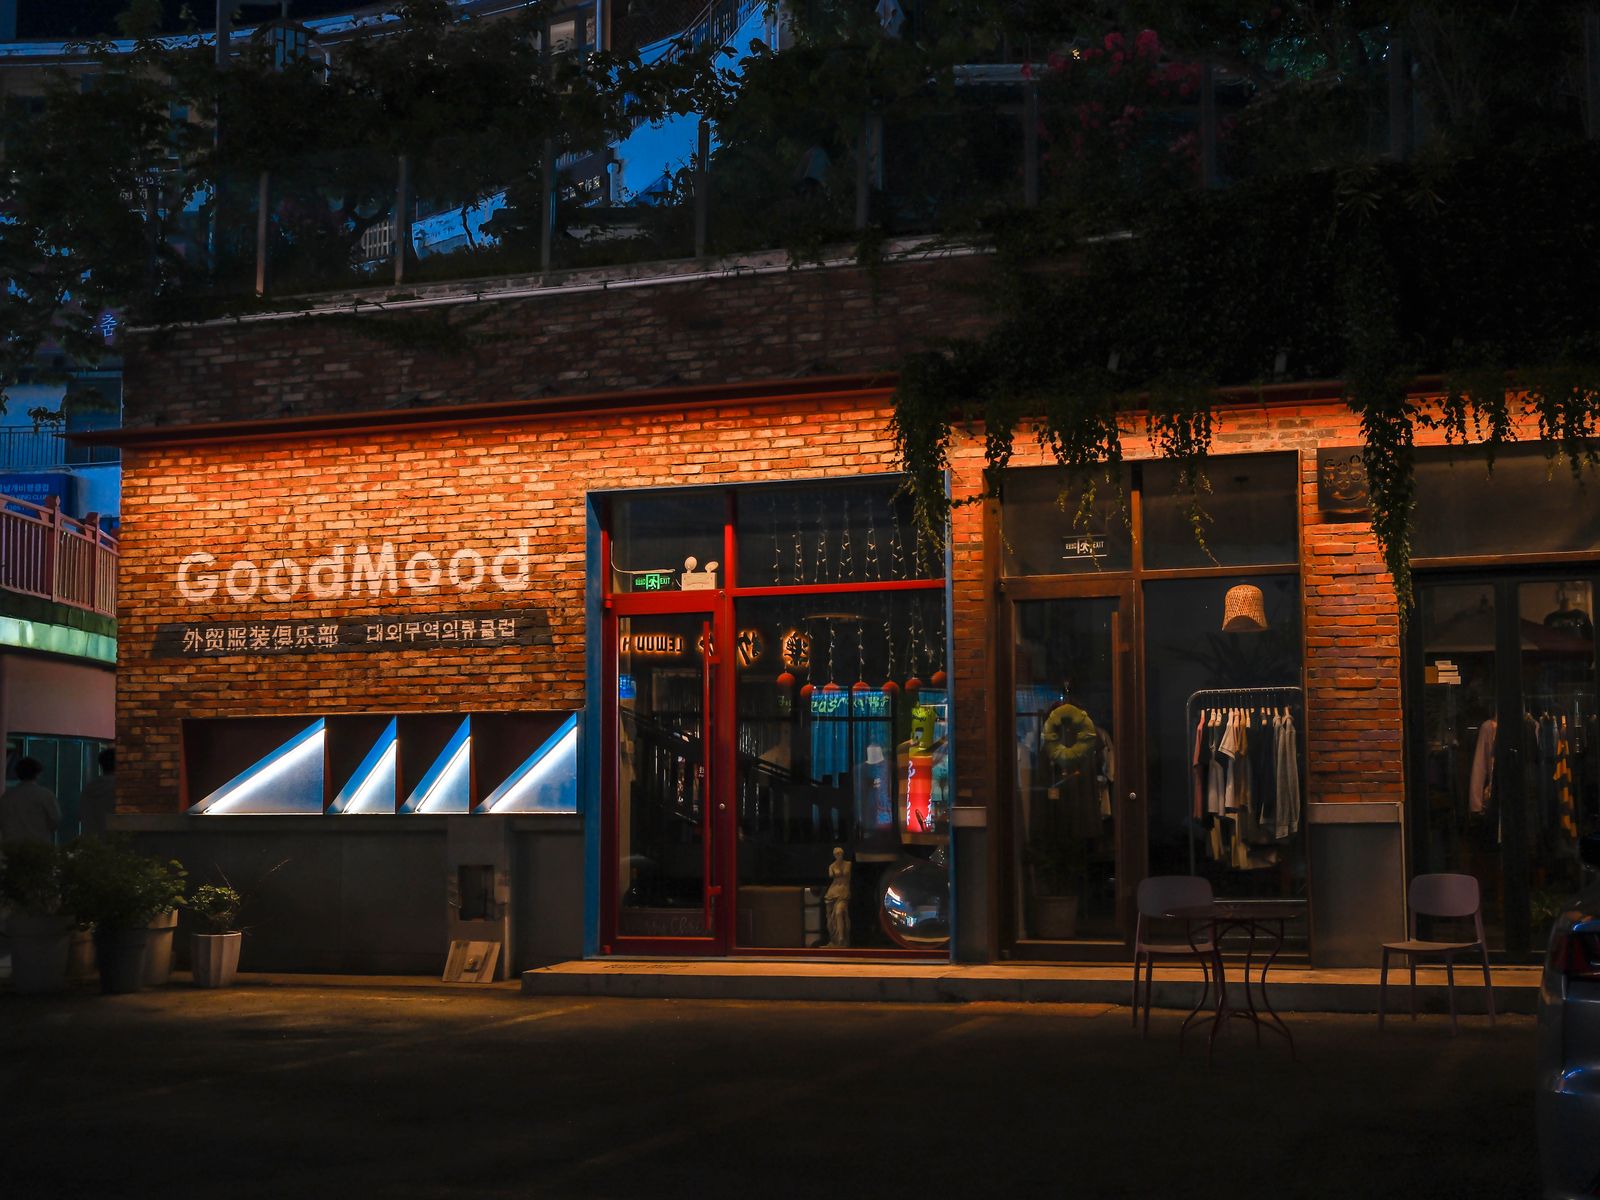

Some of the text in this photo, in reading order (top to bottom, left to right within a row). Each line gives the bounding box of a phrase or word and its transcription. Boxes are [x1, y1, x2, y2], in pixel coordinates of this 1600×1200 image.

[177, 533, 531, 602] GoodMood
[181, 624, 341, 653] 外贸服装俱乐部
